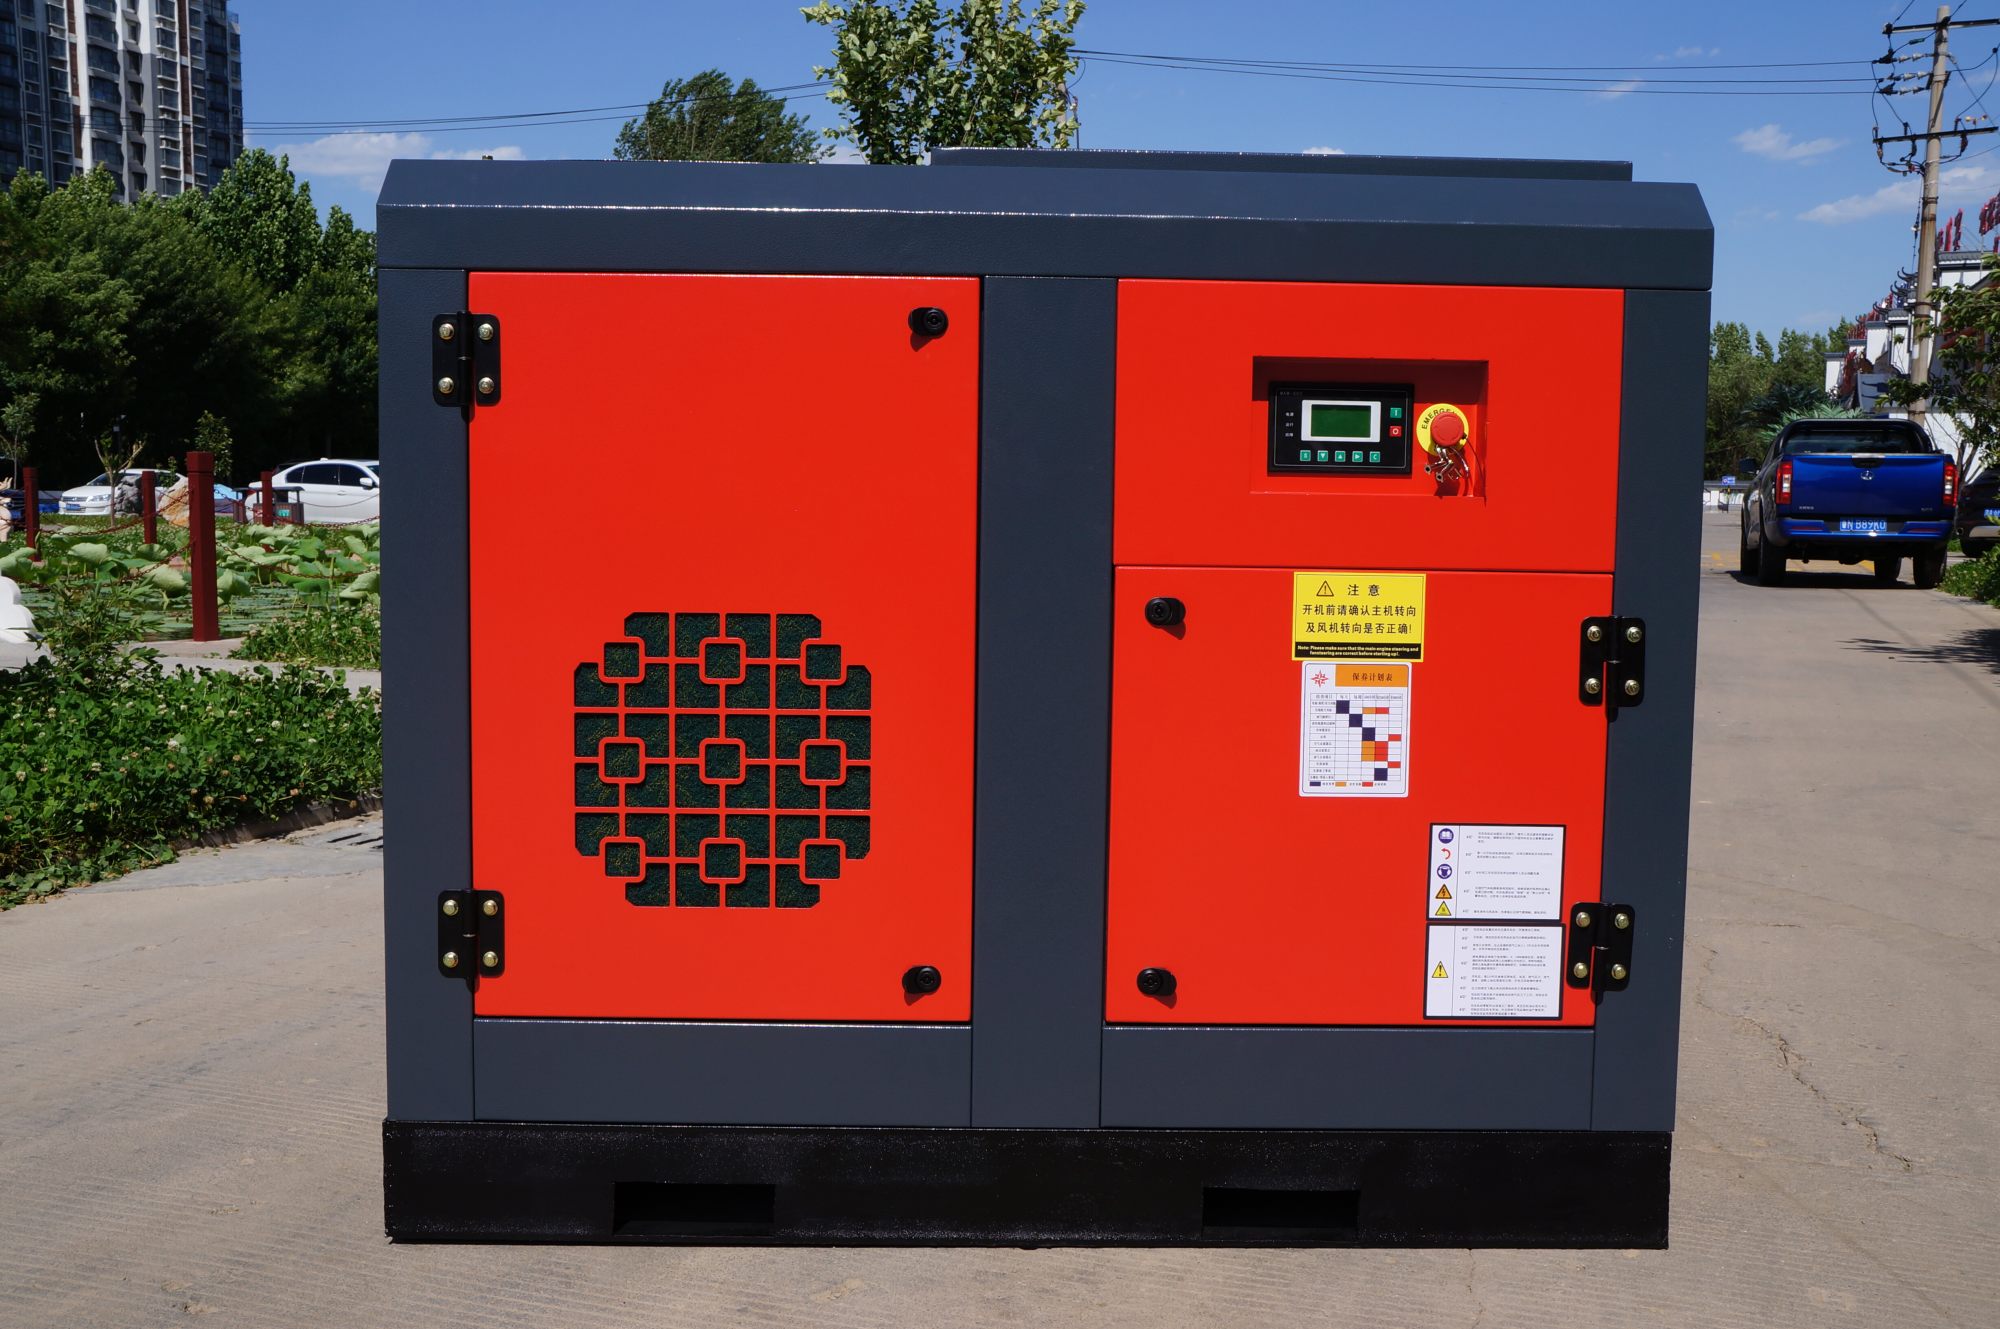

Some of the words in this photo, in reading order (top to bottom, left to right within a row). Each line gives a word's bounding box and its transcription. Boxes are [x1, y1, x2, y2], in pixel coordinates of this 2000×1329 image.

[1421, 408, 1455, 430] EMERG
[1347, 584, 1380, 596] 注意
[1302, 604, 1416, 616] 开机前请确认主机转向
[1305, 622, 1412, 634] 及风机转向是否正确!
[1352, 673, 1393, 682] 保养计划表
